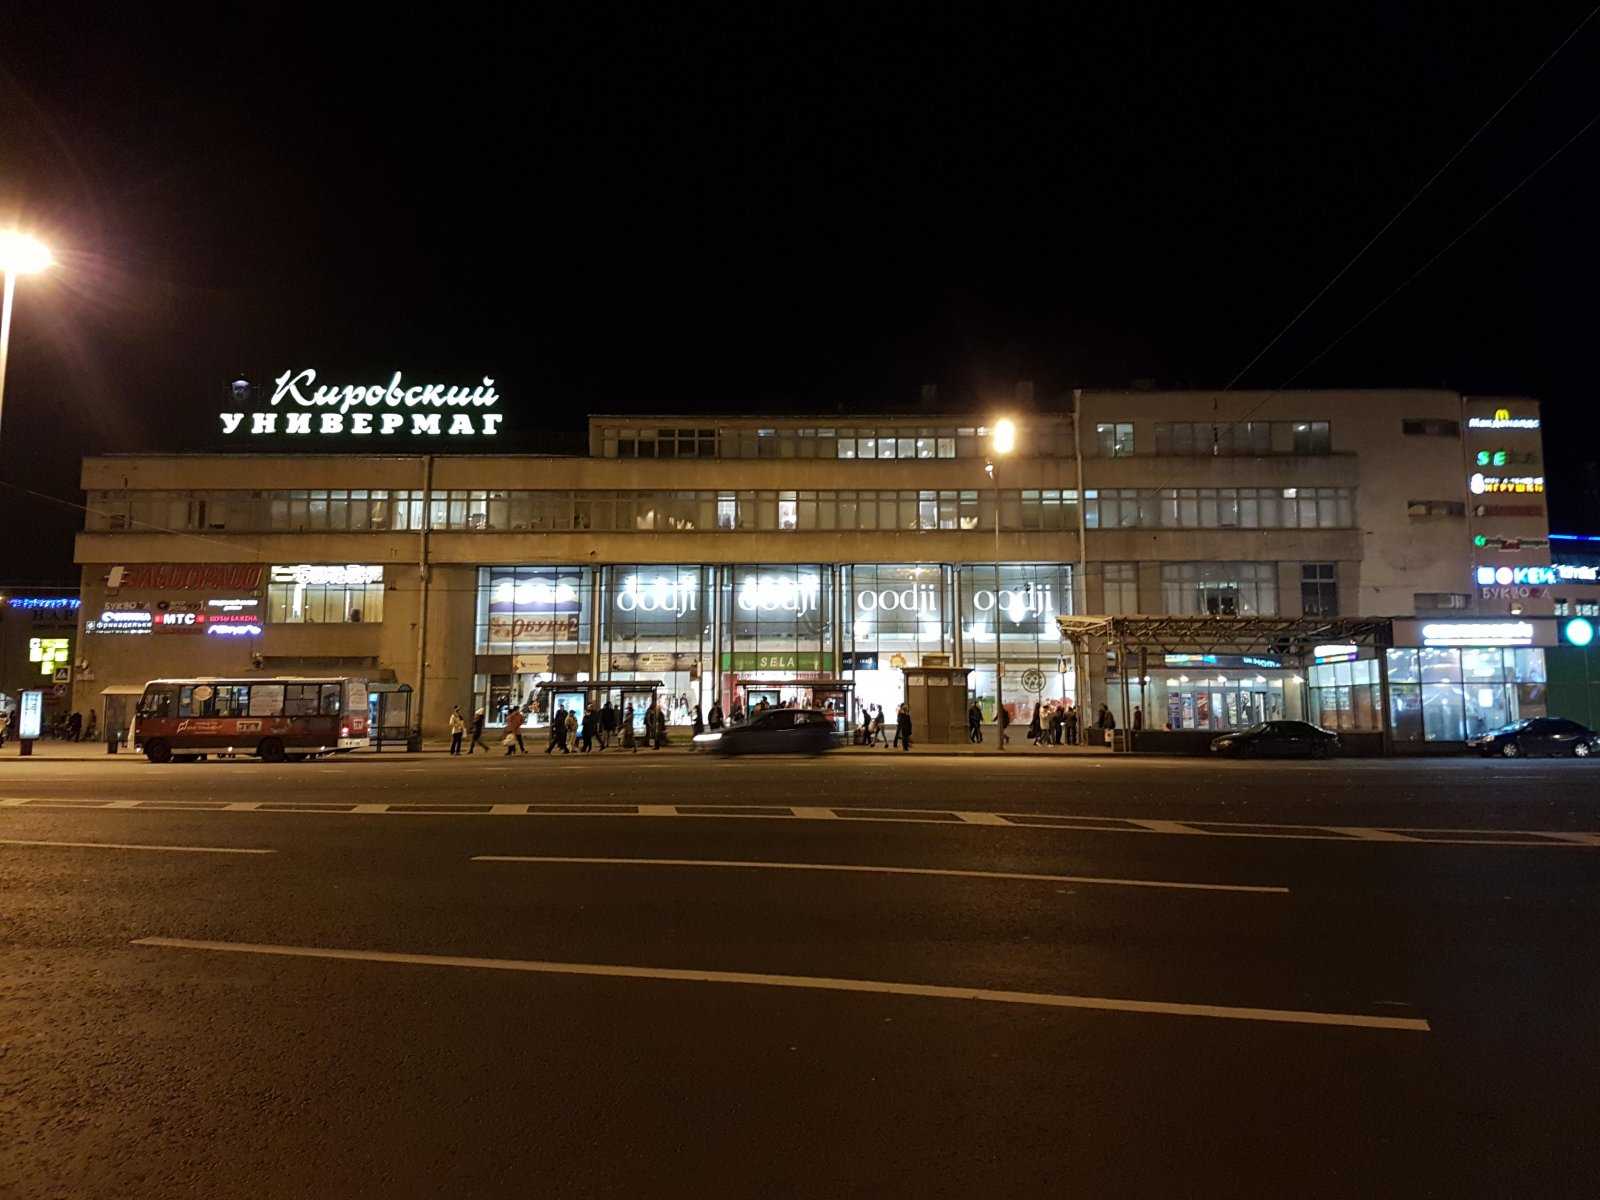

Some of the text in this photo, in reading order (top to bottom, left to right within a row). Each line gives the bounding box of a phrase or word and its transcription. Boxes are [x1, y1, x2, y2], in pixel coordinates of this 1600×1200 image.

[271, 368, 500, 414] Кировский
[220, 413, 503, 434] УНИВЕРМАГ
[617, 579, 697, 617] oodji
[857, 584, 936, 617] oodji
[974, 584, 1054, 617] oodji
[163, 613, 196, 625] МТС
[760, 657, 795, 667] SELA
